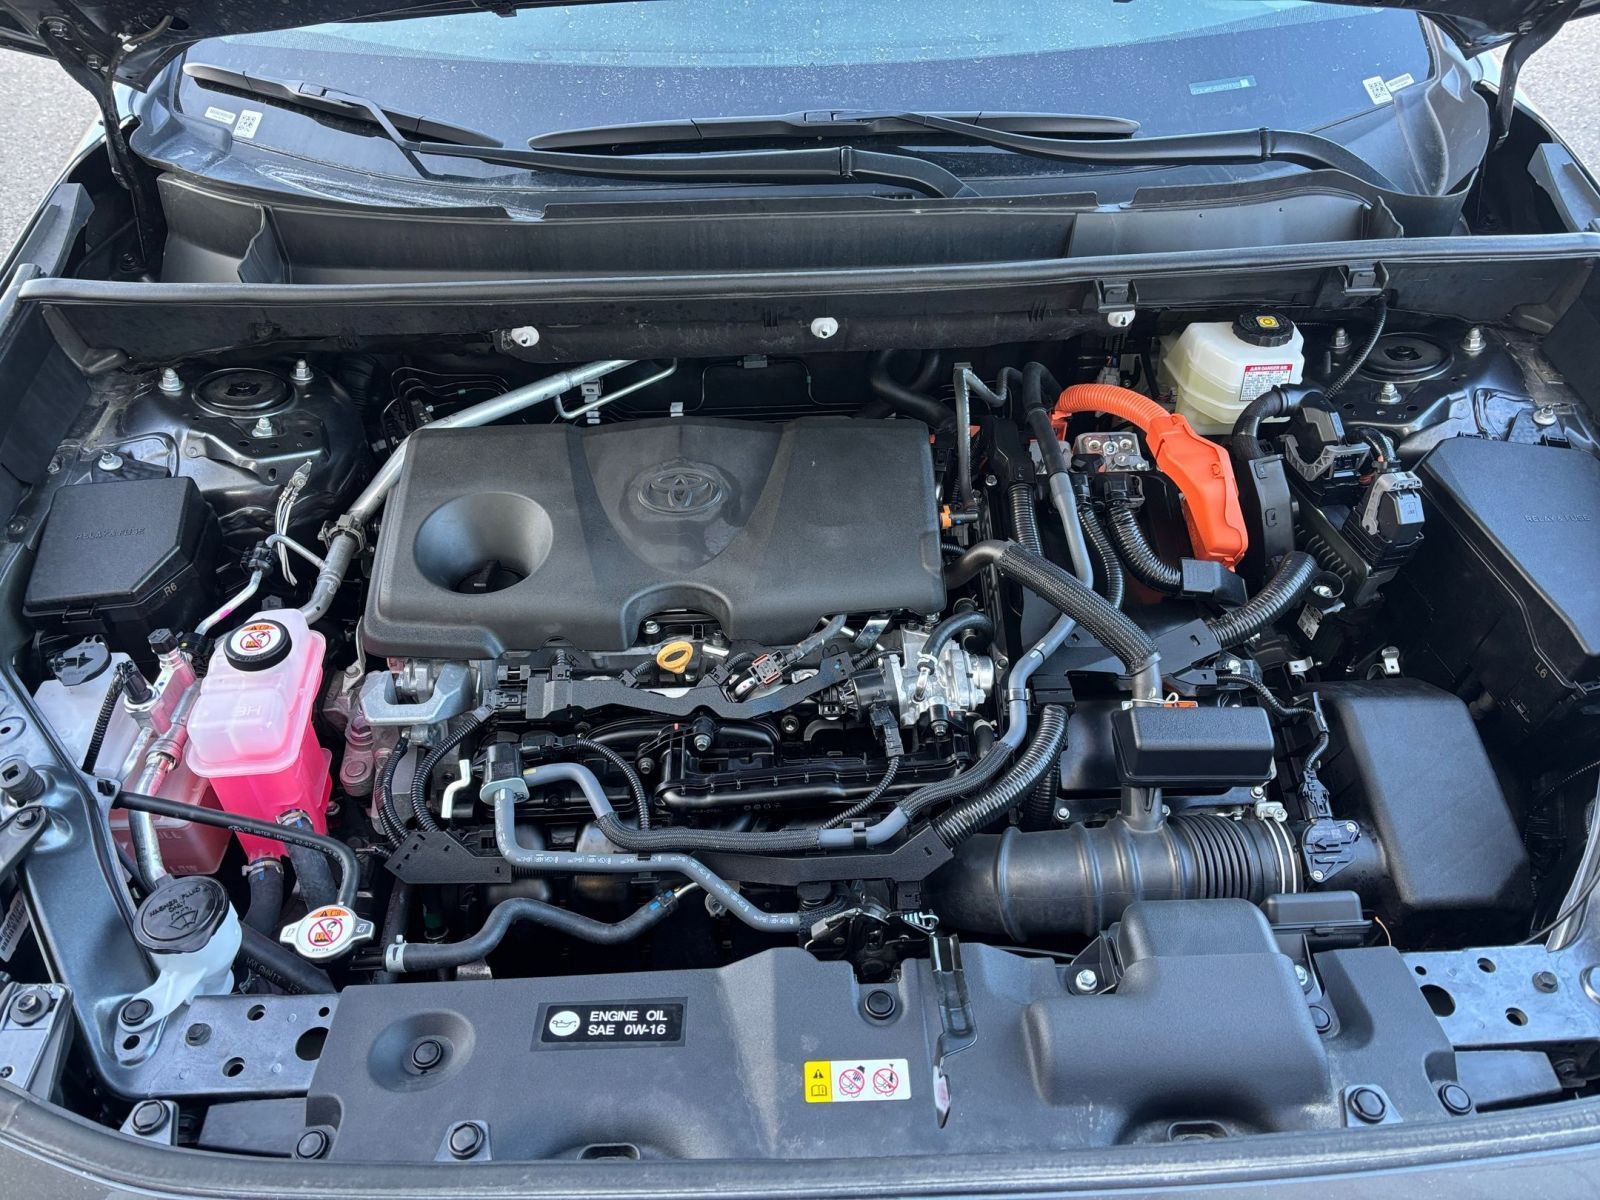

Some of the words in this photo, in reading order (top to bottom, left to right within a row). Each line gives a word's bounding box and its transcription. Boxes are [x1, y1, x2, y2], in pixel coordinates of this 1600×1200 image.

[163, 583, 177, 597] R6
[1535, 661, 1548, 679] L6
[589, 1010, 639, 1022] ENGINE
[645, 1010, 668, 1021] OIL
[587, 1024, 615, 1036] SAE
[624, 1023, 667, 1035] 0W-16
